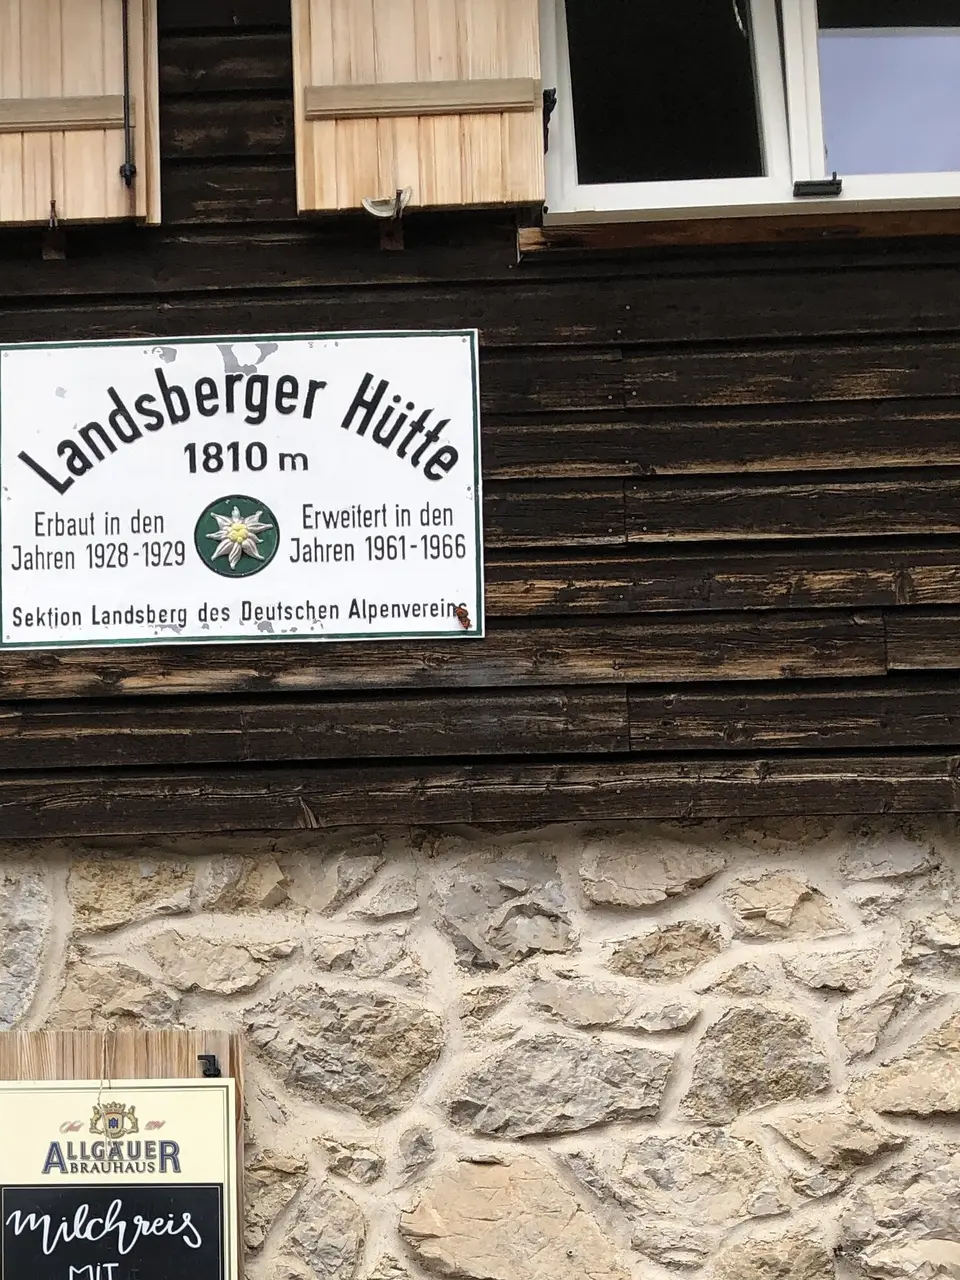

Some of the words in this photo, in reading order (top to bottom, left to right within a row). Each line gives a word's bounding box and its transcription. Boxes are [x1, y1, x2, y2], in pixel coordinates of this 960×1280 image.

[18, 367, 327, 495] Landsberger
[341, 372, 459, 481] Hütte
[184, 441, 268, 474] 1810
[279, 452, 309, 472] m
[35, 511, 95, 537] Erbaut
[104, 511, 120, 536] in
[130, 508, 165, 535] den
[302, 503, 387, 530] Erweitert
[395, 504, 411, 528] in
[420, 501, 453, 526] den
[11, 544, 75, 571] Jahren
[290, 537, 355, 563] Jahren
[12, 606, 82, 627] Sektion
[91, 604, 187, 628] Landsberg
[198, 602, 230, 623] des
[241, 600, 339, 621] Deutschen
[41, 1140, 182, 1174] ALLGÄUER
[70, 1162, 155, 1174] BRAUHAUS
